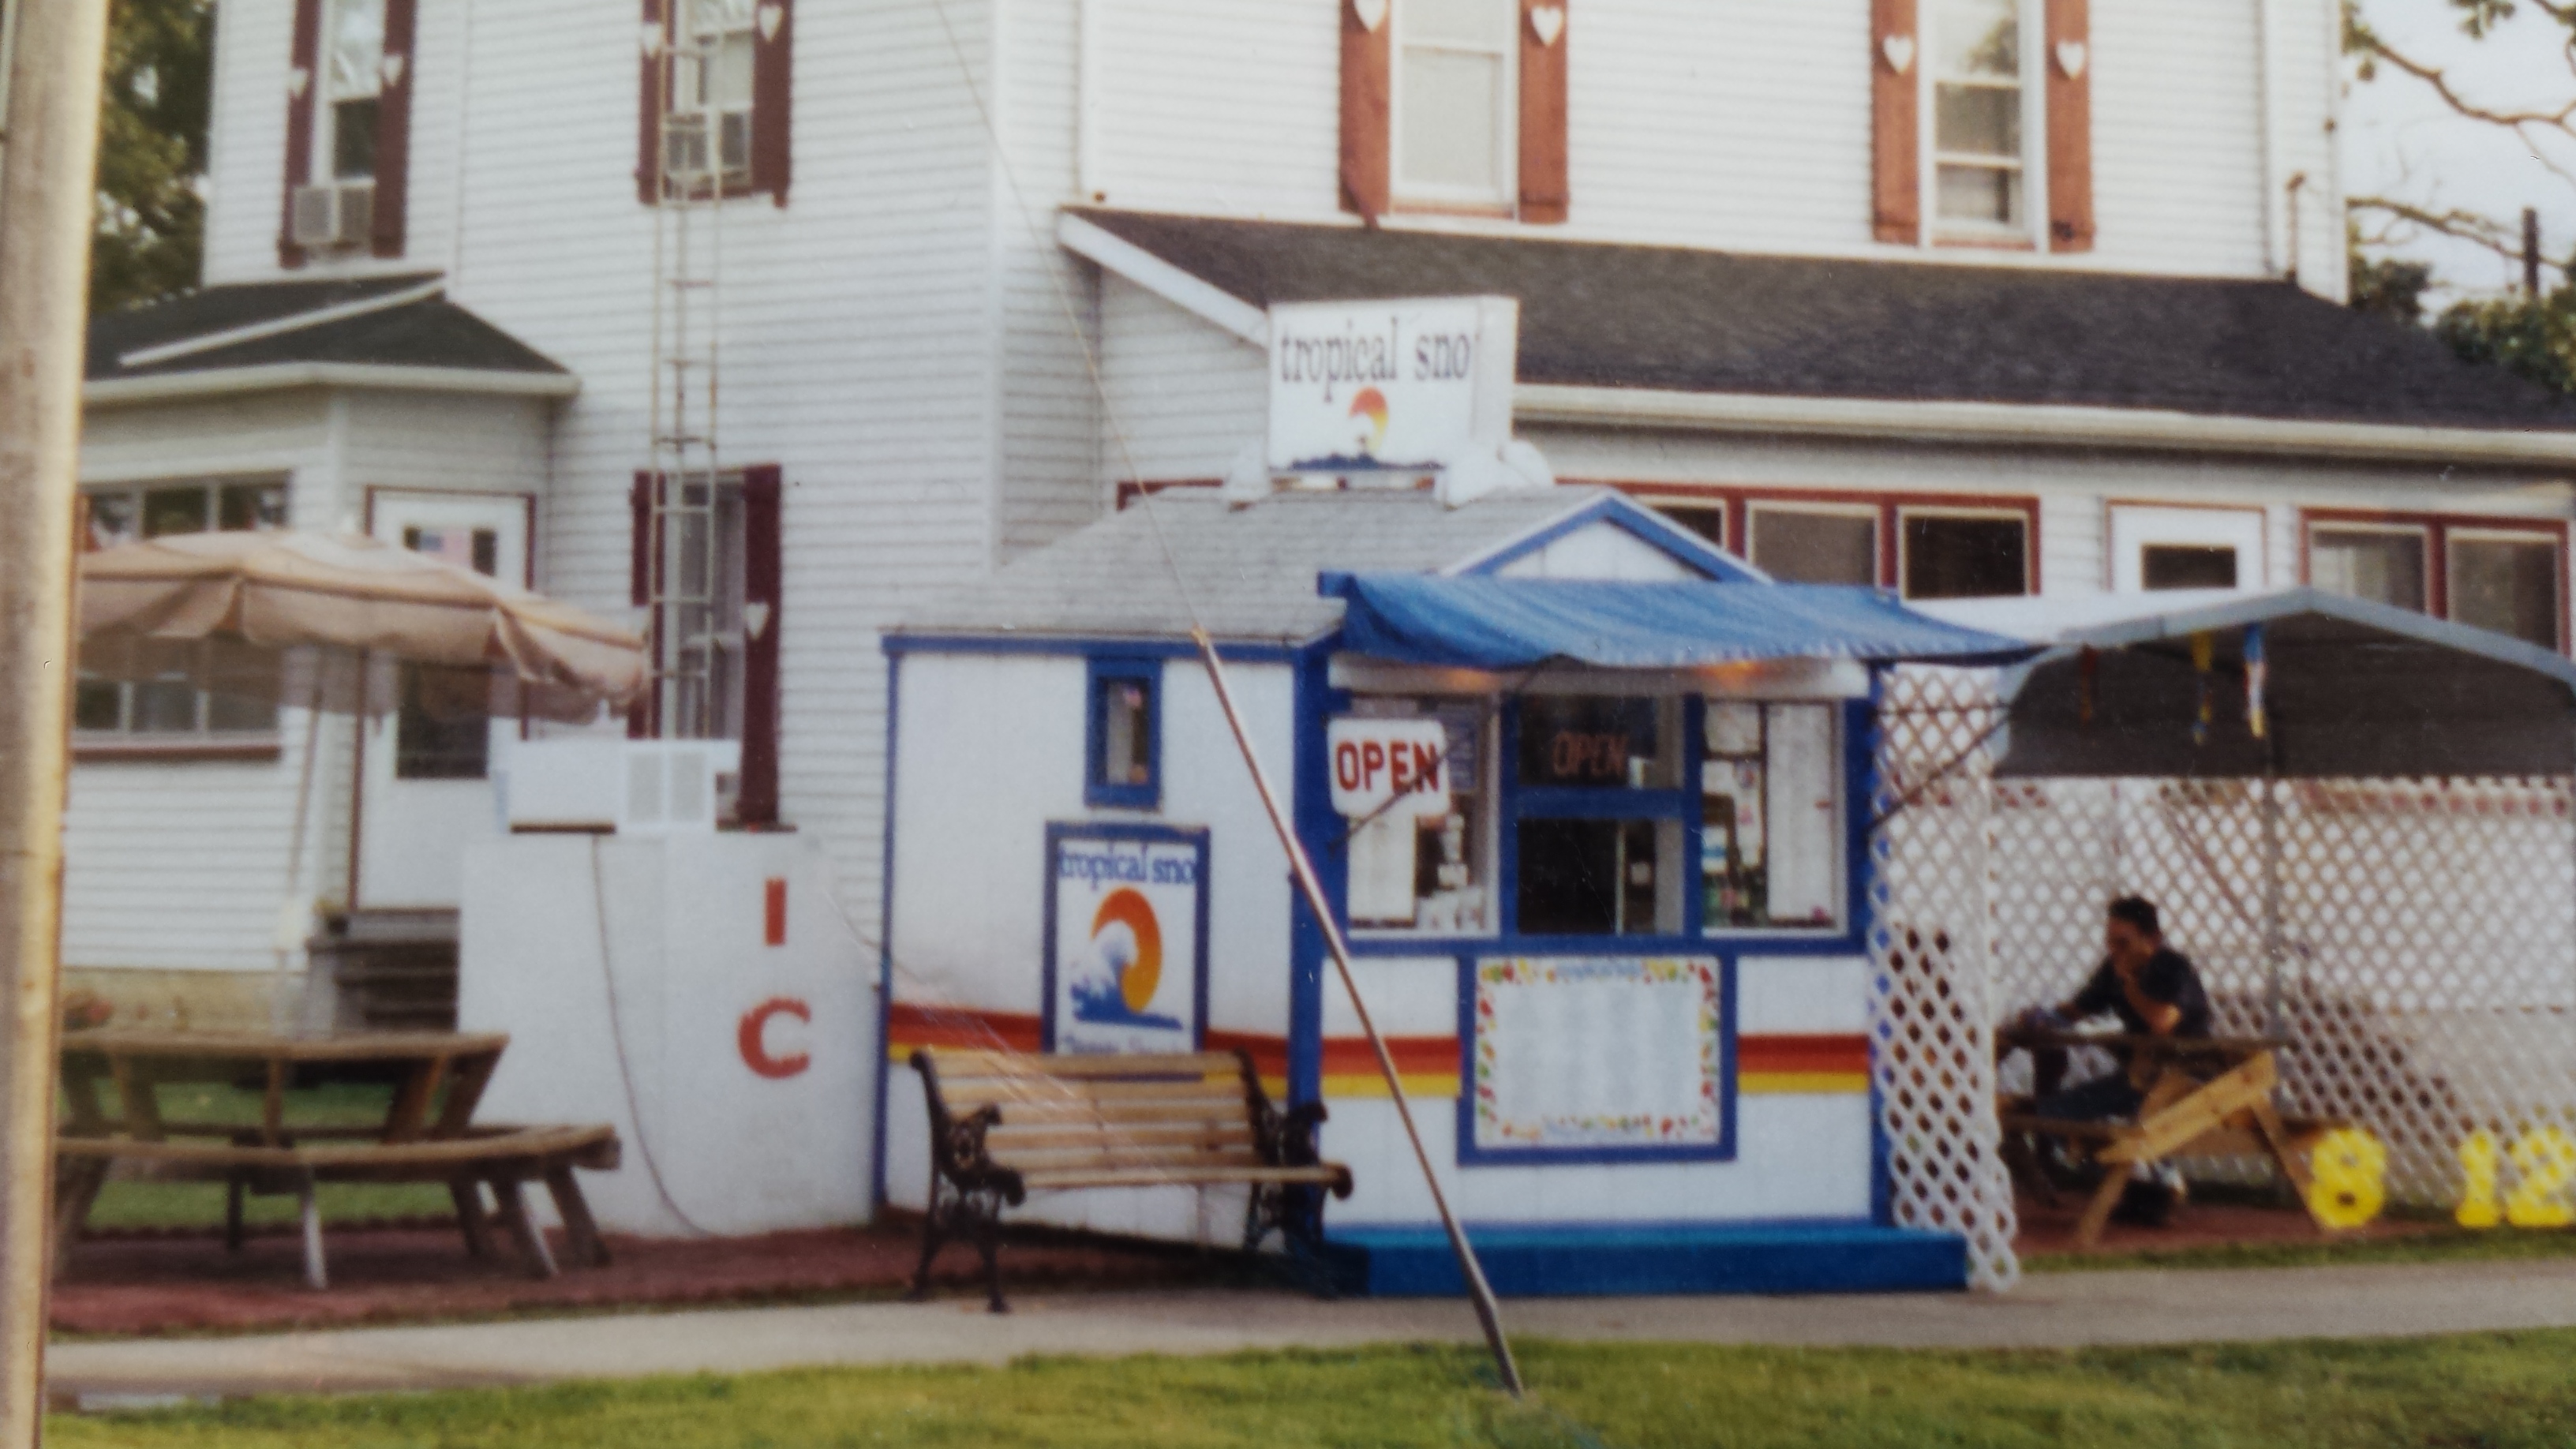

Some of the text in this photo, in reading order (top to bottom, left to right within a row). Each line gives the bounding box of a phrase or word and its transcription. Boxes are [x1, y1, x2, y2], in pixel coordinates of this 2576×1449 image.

[1280, 316, 1398, 403] tropical
[1336, 739, 1440, 793] OPEN
[1552, 731, 1629, 777] OPEN
[1058, 843, 1147, 892] tropical
